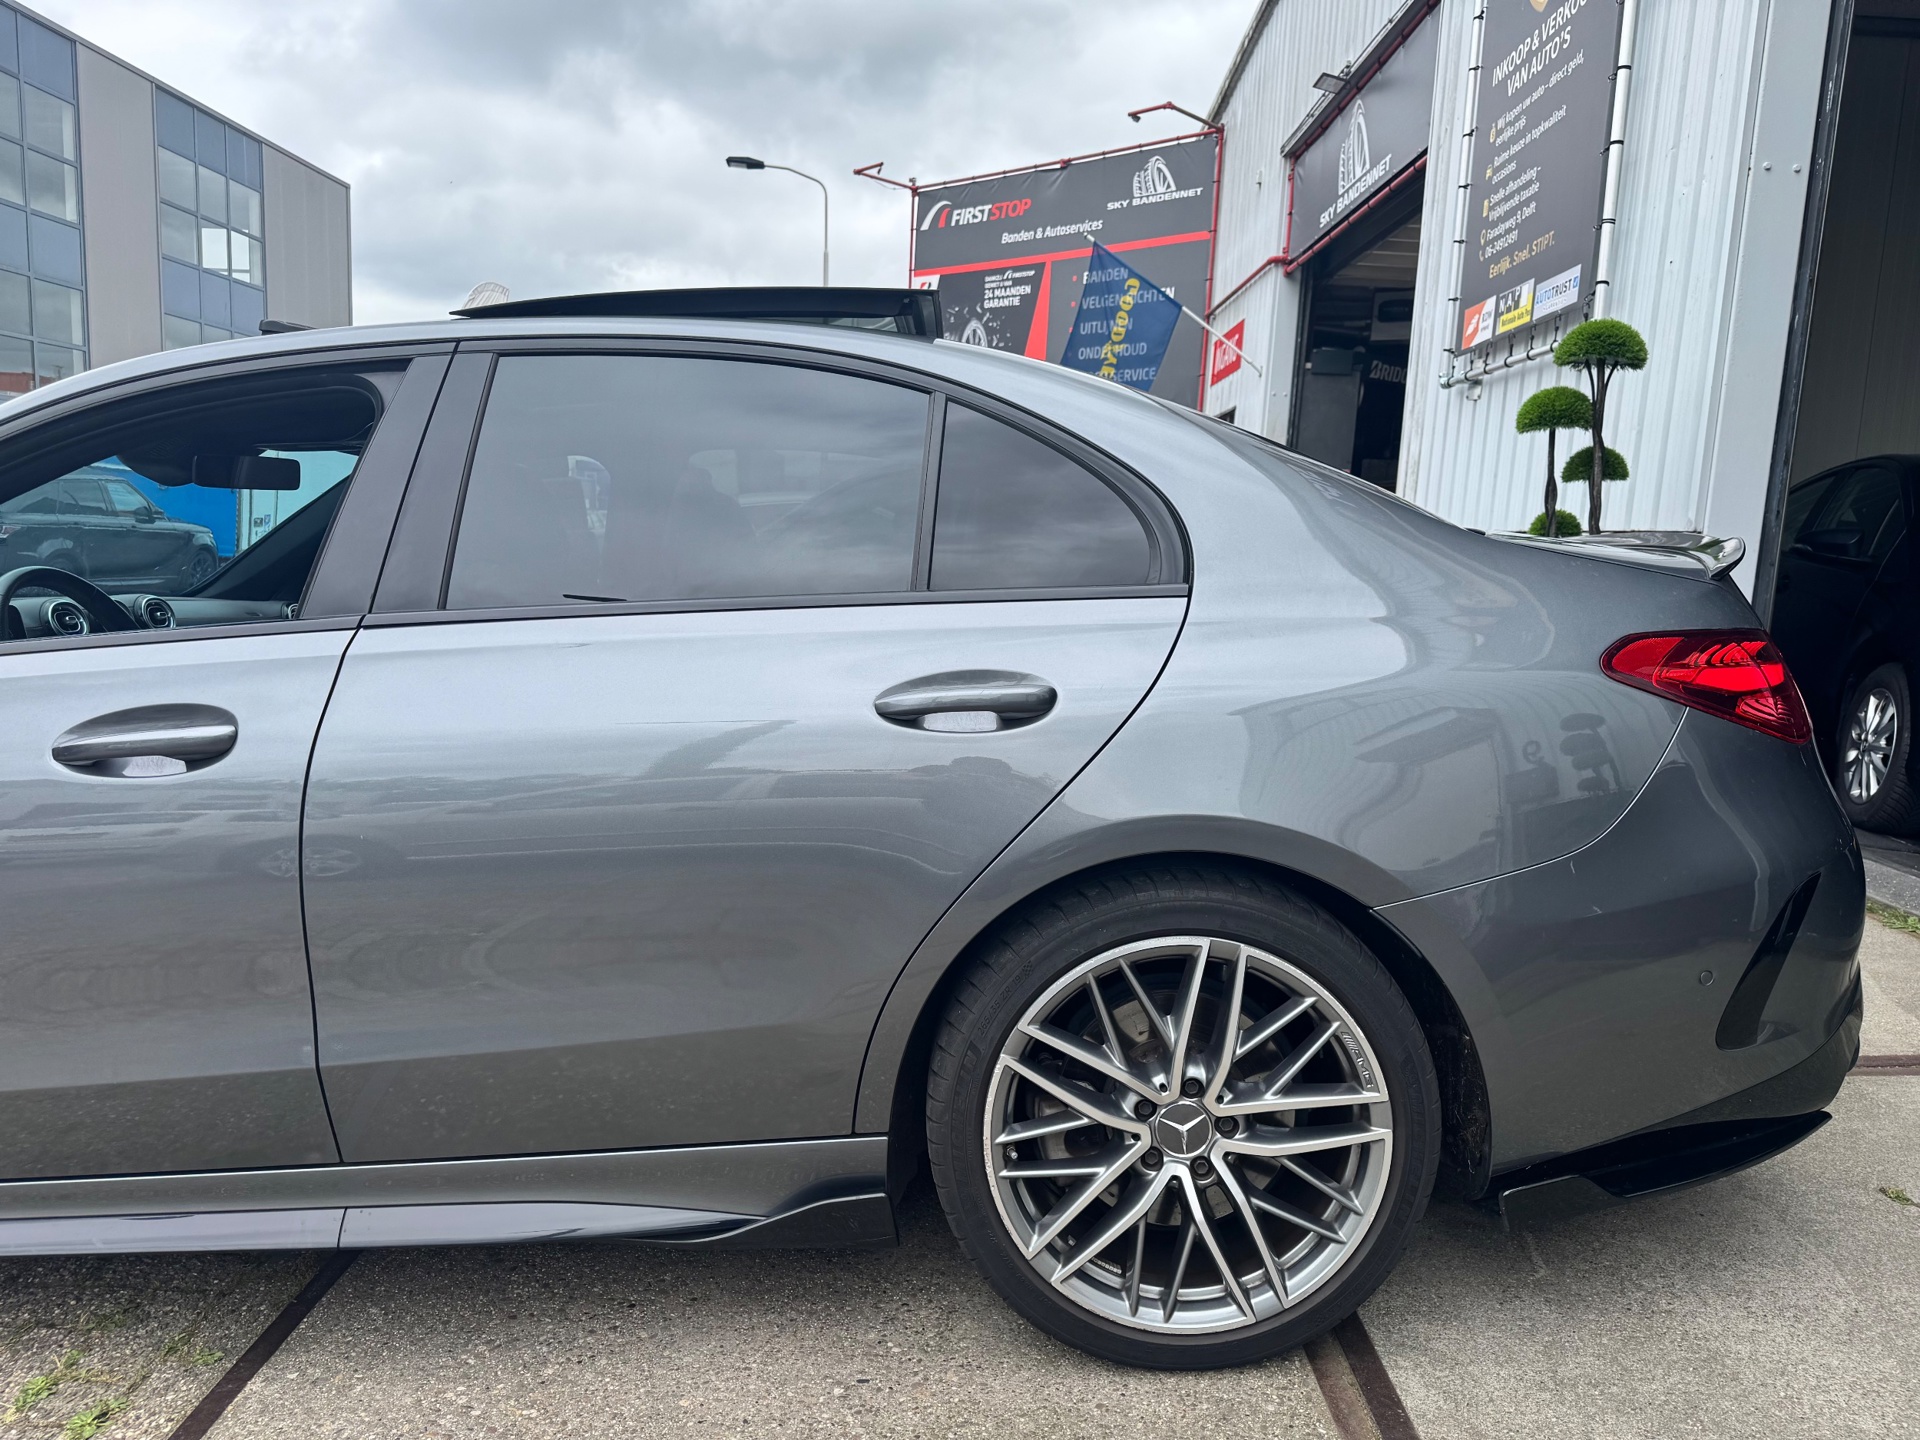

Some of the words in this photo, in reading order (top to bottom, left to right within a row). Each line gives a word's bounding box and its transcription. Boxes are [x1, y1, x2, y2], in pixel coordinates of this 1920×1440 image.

[1492, 37, 1531, 87] INKOOP
[1532, 29, 1540, 51] &
[1507, 63, 1529, 97] VAN
[1529, 26, 1572, 80] AUTO'S
[1506, 103, 1522, 124] kopen
[1531, 85, 1545, 102] auto
[1549, 64, 1567, 88] direct
[1510, 137, 1525, 156] keuze
[1525, 132, 1532, 145] in
[1532, 104, 1567, 140] topkwaliteit
[1106, 199, 1130, 211] SKY
[1132, 187, 1204, 206] BANDENNET
[1320, 203, 1336, 229] SKY
[1337, 153, 1392, 214] BANDENNET
[1489, 188, 1505, 206] Snelle
[1505, 166, 1537, 196] afhandeling
[1520, 180, 1540, 201] taxatie
[1001, 231, 1034, 244] Banden
[1035, 227, 1043, 240] &
[1044, 219, 1104, 238] Autoservices
[1486, 215, 1516, 241] Faradayweg
[1522, 201, 1537, 220] Delft
[1513, 244, 1531, 266] Snel.
[1531, 230, 1555, 256] STIPT.
[984, 289, 993, 299] 24
[994, 284, 1031, 298] MAANDEN
[1083, 267, 1128, 285] BANDEN
[983, 296, 1021, 308] GARANTIE
[1078, 342, 1147, 360] ONDEHOUD
